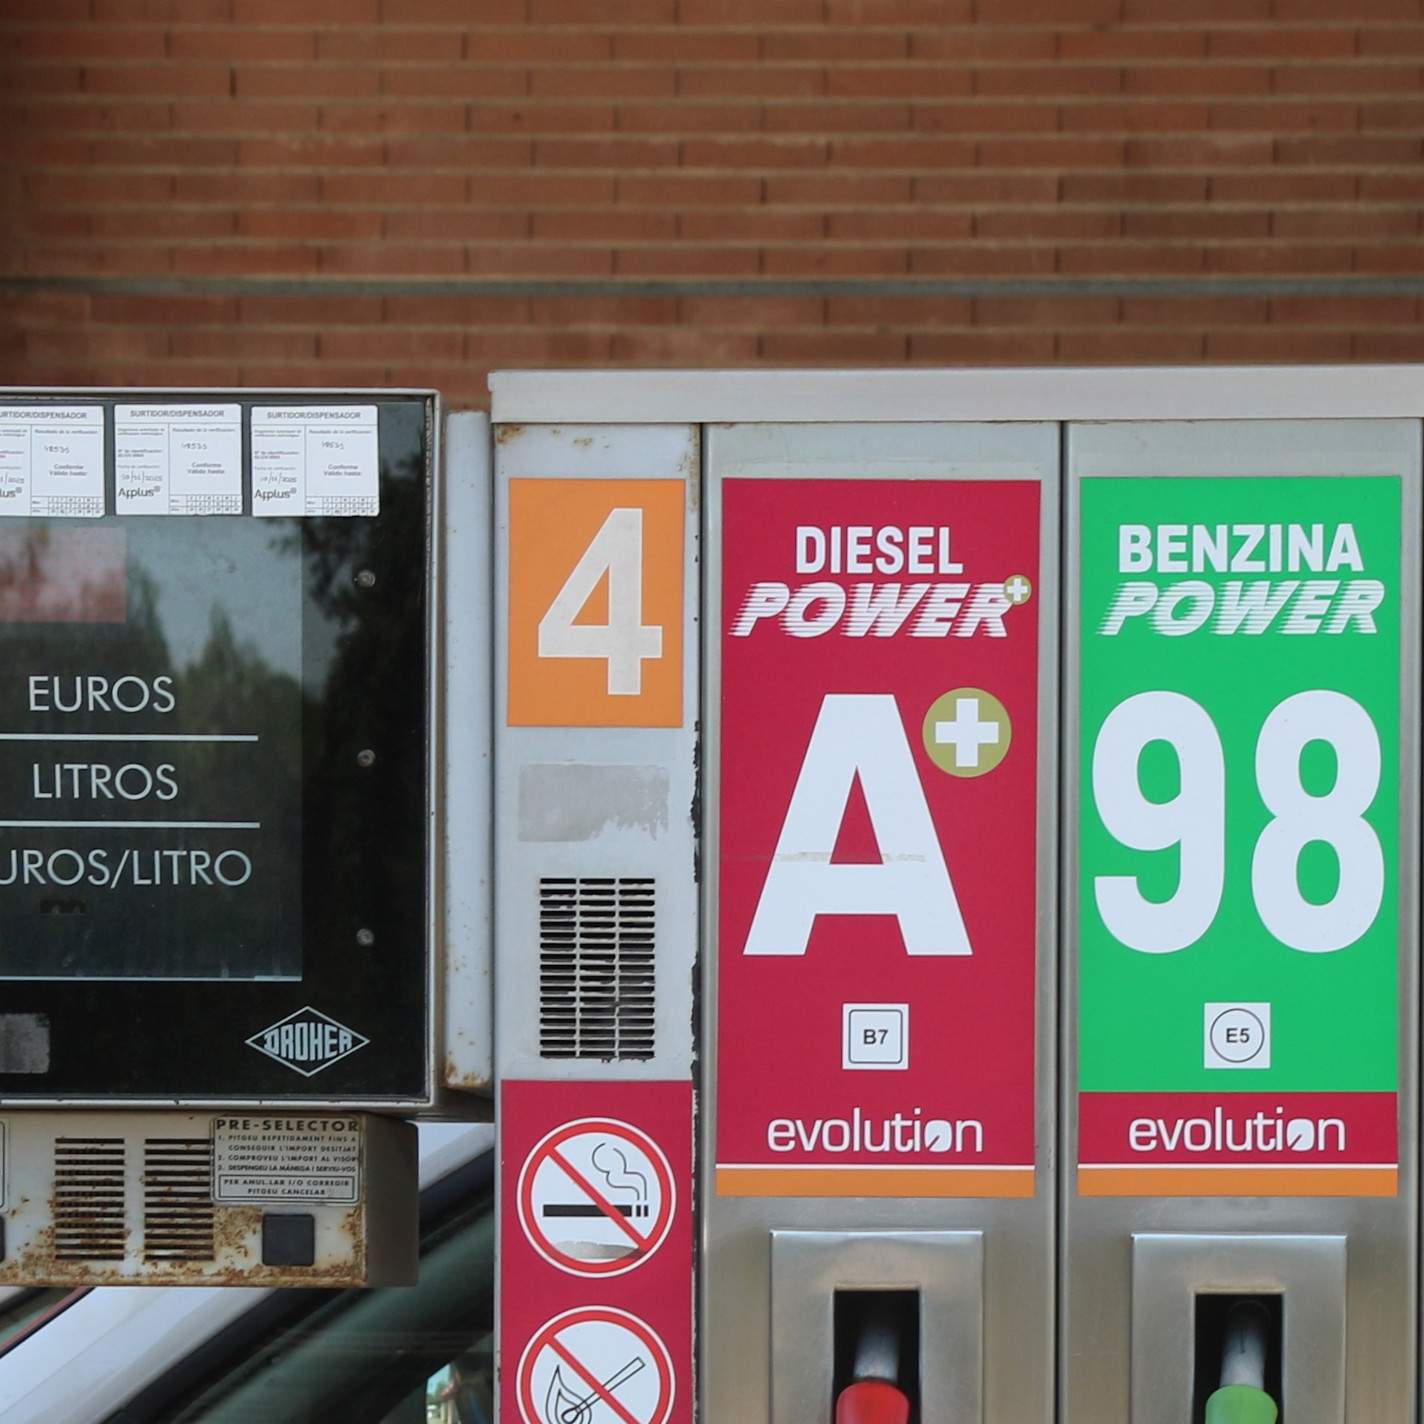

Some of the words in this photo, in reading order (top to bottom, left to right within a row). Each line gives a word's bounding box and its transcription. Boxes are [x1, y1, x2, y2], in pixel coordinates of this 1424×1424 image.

[795, 526, 964, 574] DIESEL
[1118, 523, 1364, 573] BENZINA
[538, 508, 663, 696] 4
[1095, 579, 1385, 637] POWER
[28, 675, 176, 713] EUROS
[33, 763, 179, 801] LITROS
[1091, 689, 1386, 954] 98
[862, 1028, 889, 1046] B7
[1224, 1027, 1251, 1045] E5
[216, 1120, 359, 1131] PRE-SELECTOR
[767, 1107, 984, 1152] evolution
[1128, 1106, 1346, 1152] evolution
